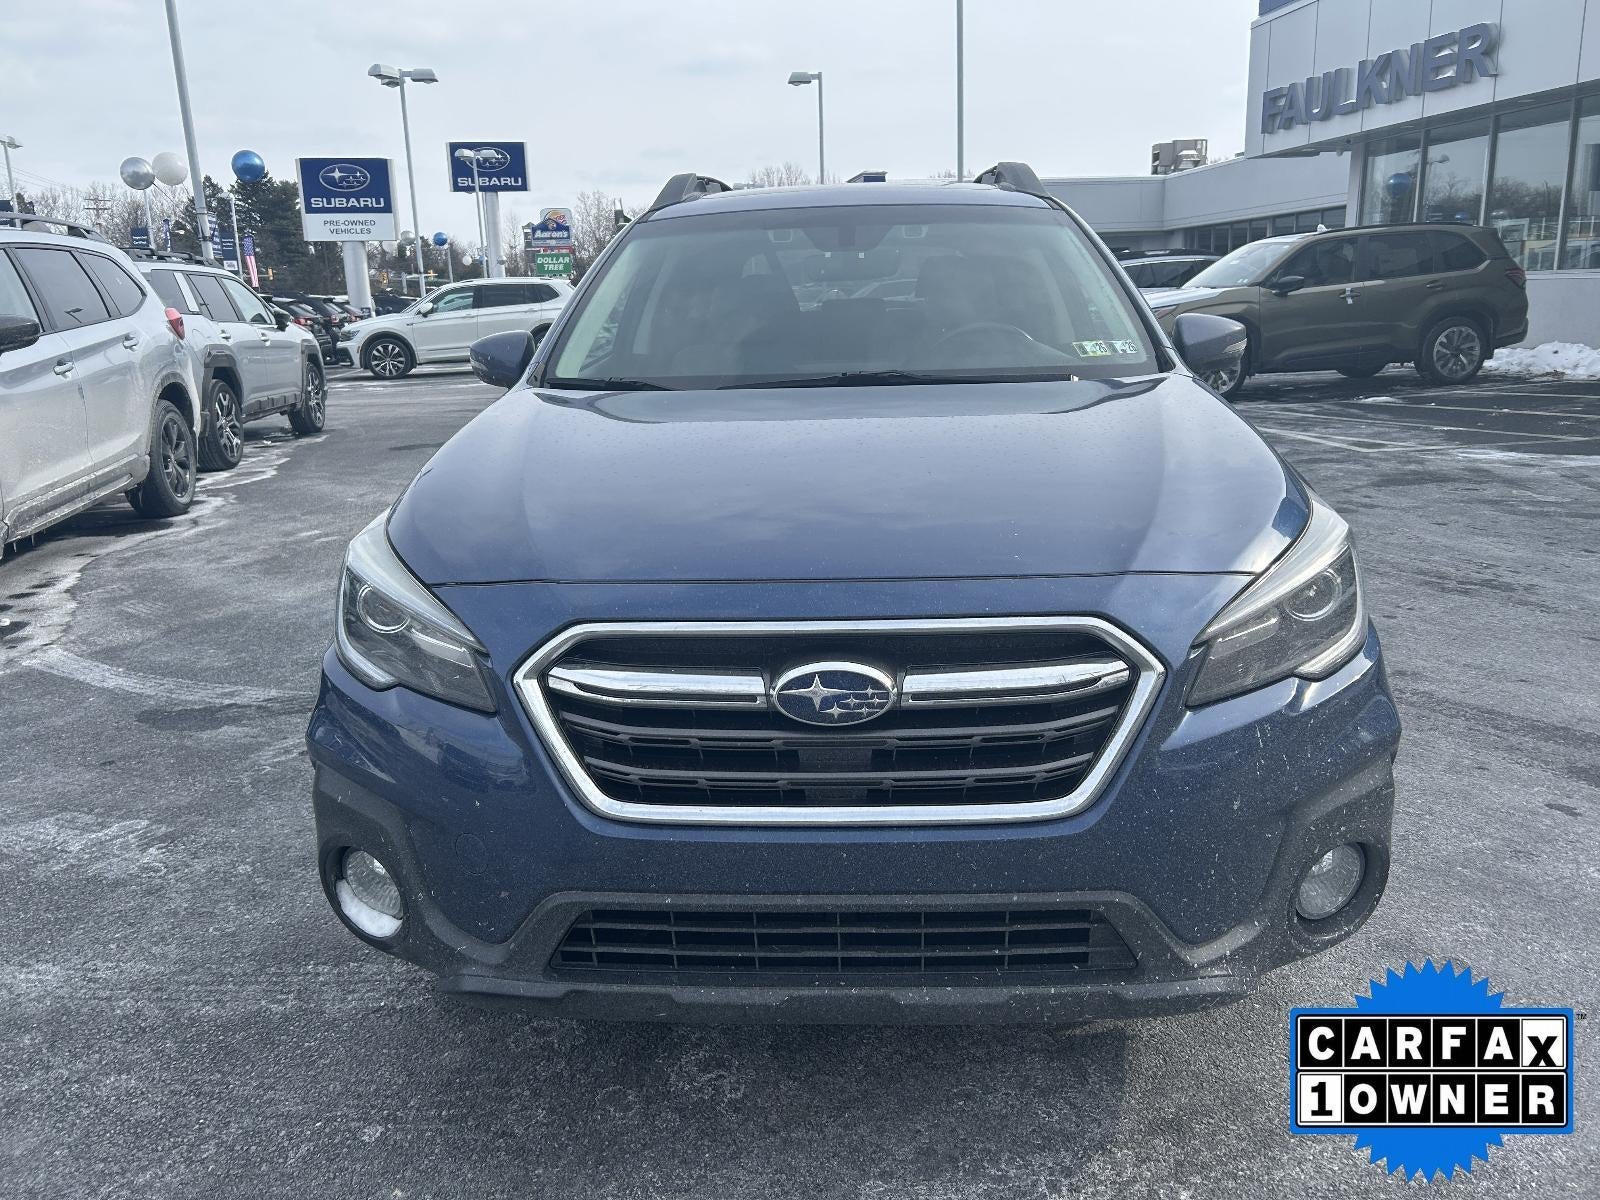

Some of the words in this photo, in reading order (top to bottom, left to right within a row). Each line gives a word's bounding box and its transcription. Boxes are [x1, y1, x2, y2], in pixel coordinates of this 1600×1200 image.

[1261, 22, 1499, 134] FAULKNER
[310, 197, 385, 208] SUBARU
[323, 219, 376, 227] PRE-OWNED
[329, 227, 372, 235] VEHICLES
[534, 230, 568, 238] Aaron's
